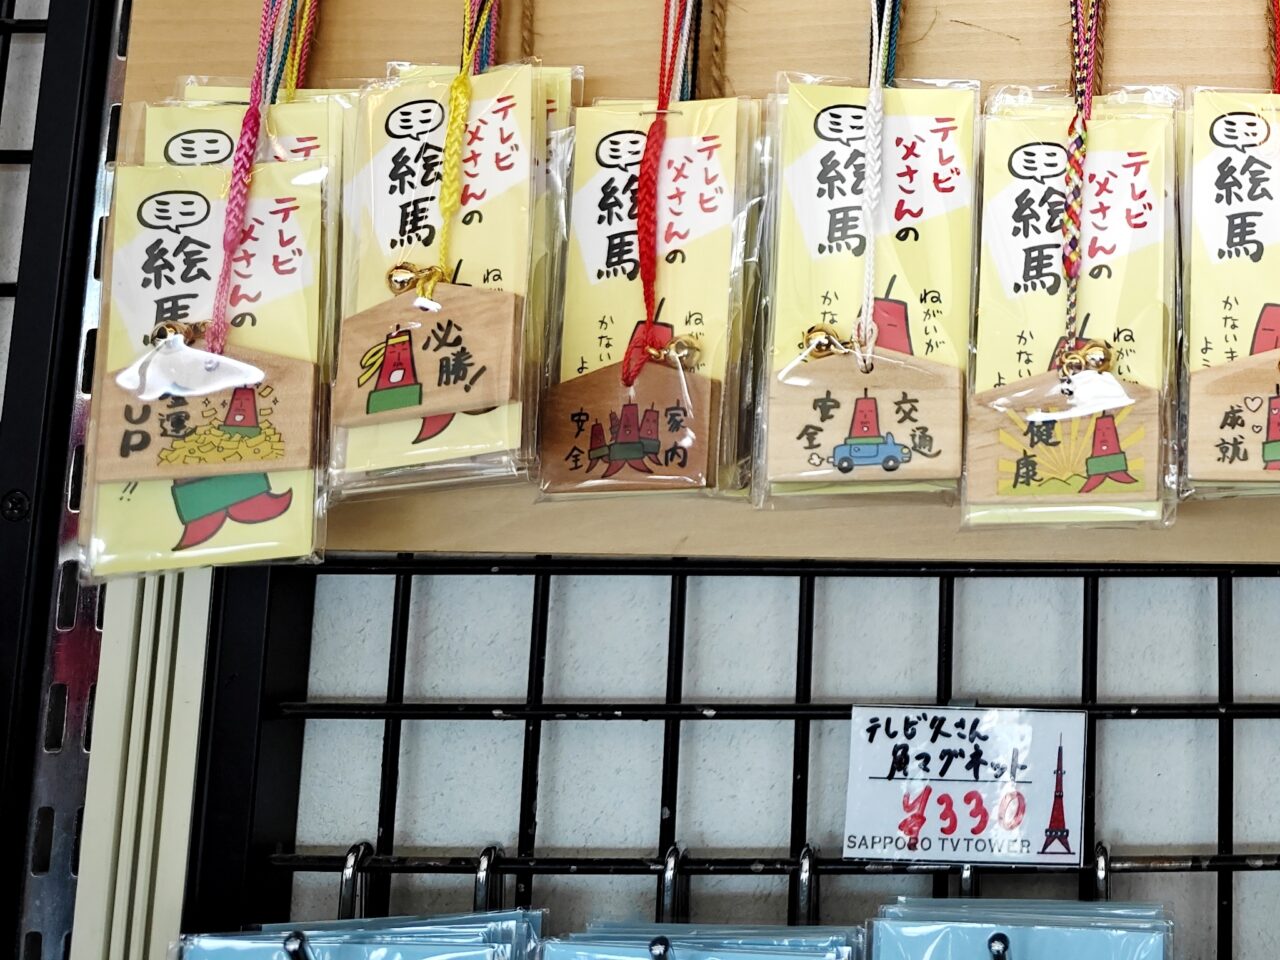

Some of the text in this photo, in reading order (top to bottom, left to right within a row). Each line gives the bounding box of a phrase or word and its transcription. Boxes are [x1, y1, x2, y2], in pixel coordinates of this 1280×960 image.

[399, 108, 432, 130] ミニ
[492, 95, 519, 171] テレビ
[609, 140, 641, 160] ミニ
[829, 112, 864, 133] ミニ
[930, 117, 960, 193] テレビ
[388, 142, 443, 249] 絵馬
[461, 118, 488, 226] 父さんの
[697, 135, 723, 213] テレビ
[894, 134, 924, 241] 父さんの
[1023, 151, 1058, 171] ミニ
[1122, 151, 1153, 229] テレビ
[154, 199, 196, 220] ミニ
[269, 196, 303, 275] テレビ
[665, 155, 692, 264] 父さんの
[1011, 187, 1066, 296] 絵馬
[1088, 170, 1118, 279] 父さんの
[1214, 155, 1273, 263] 絵馬
[920, 289, 946, 355] ねがいが
[565, 407, 590, 471] 安全
[664, 400, 689, 468] 家内
[894, 392, 942, 458] 交通
[1214, 405, 1249, 464] 成就
[847, 835, 932, 852] SAPPORO
[898, 785, 1027, 851] ¥330
